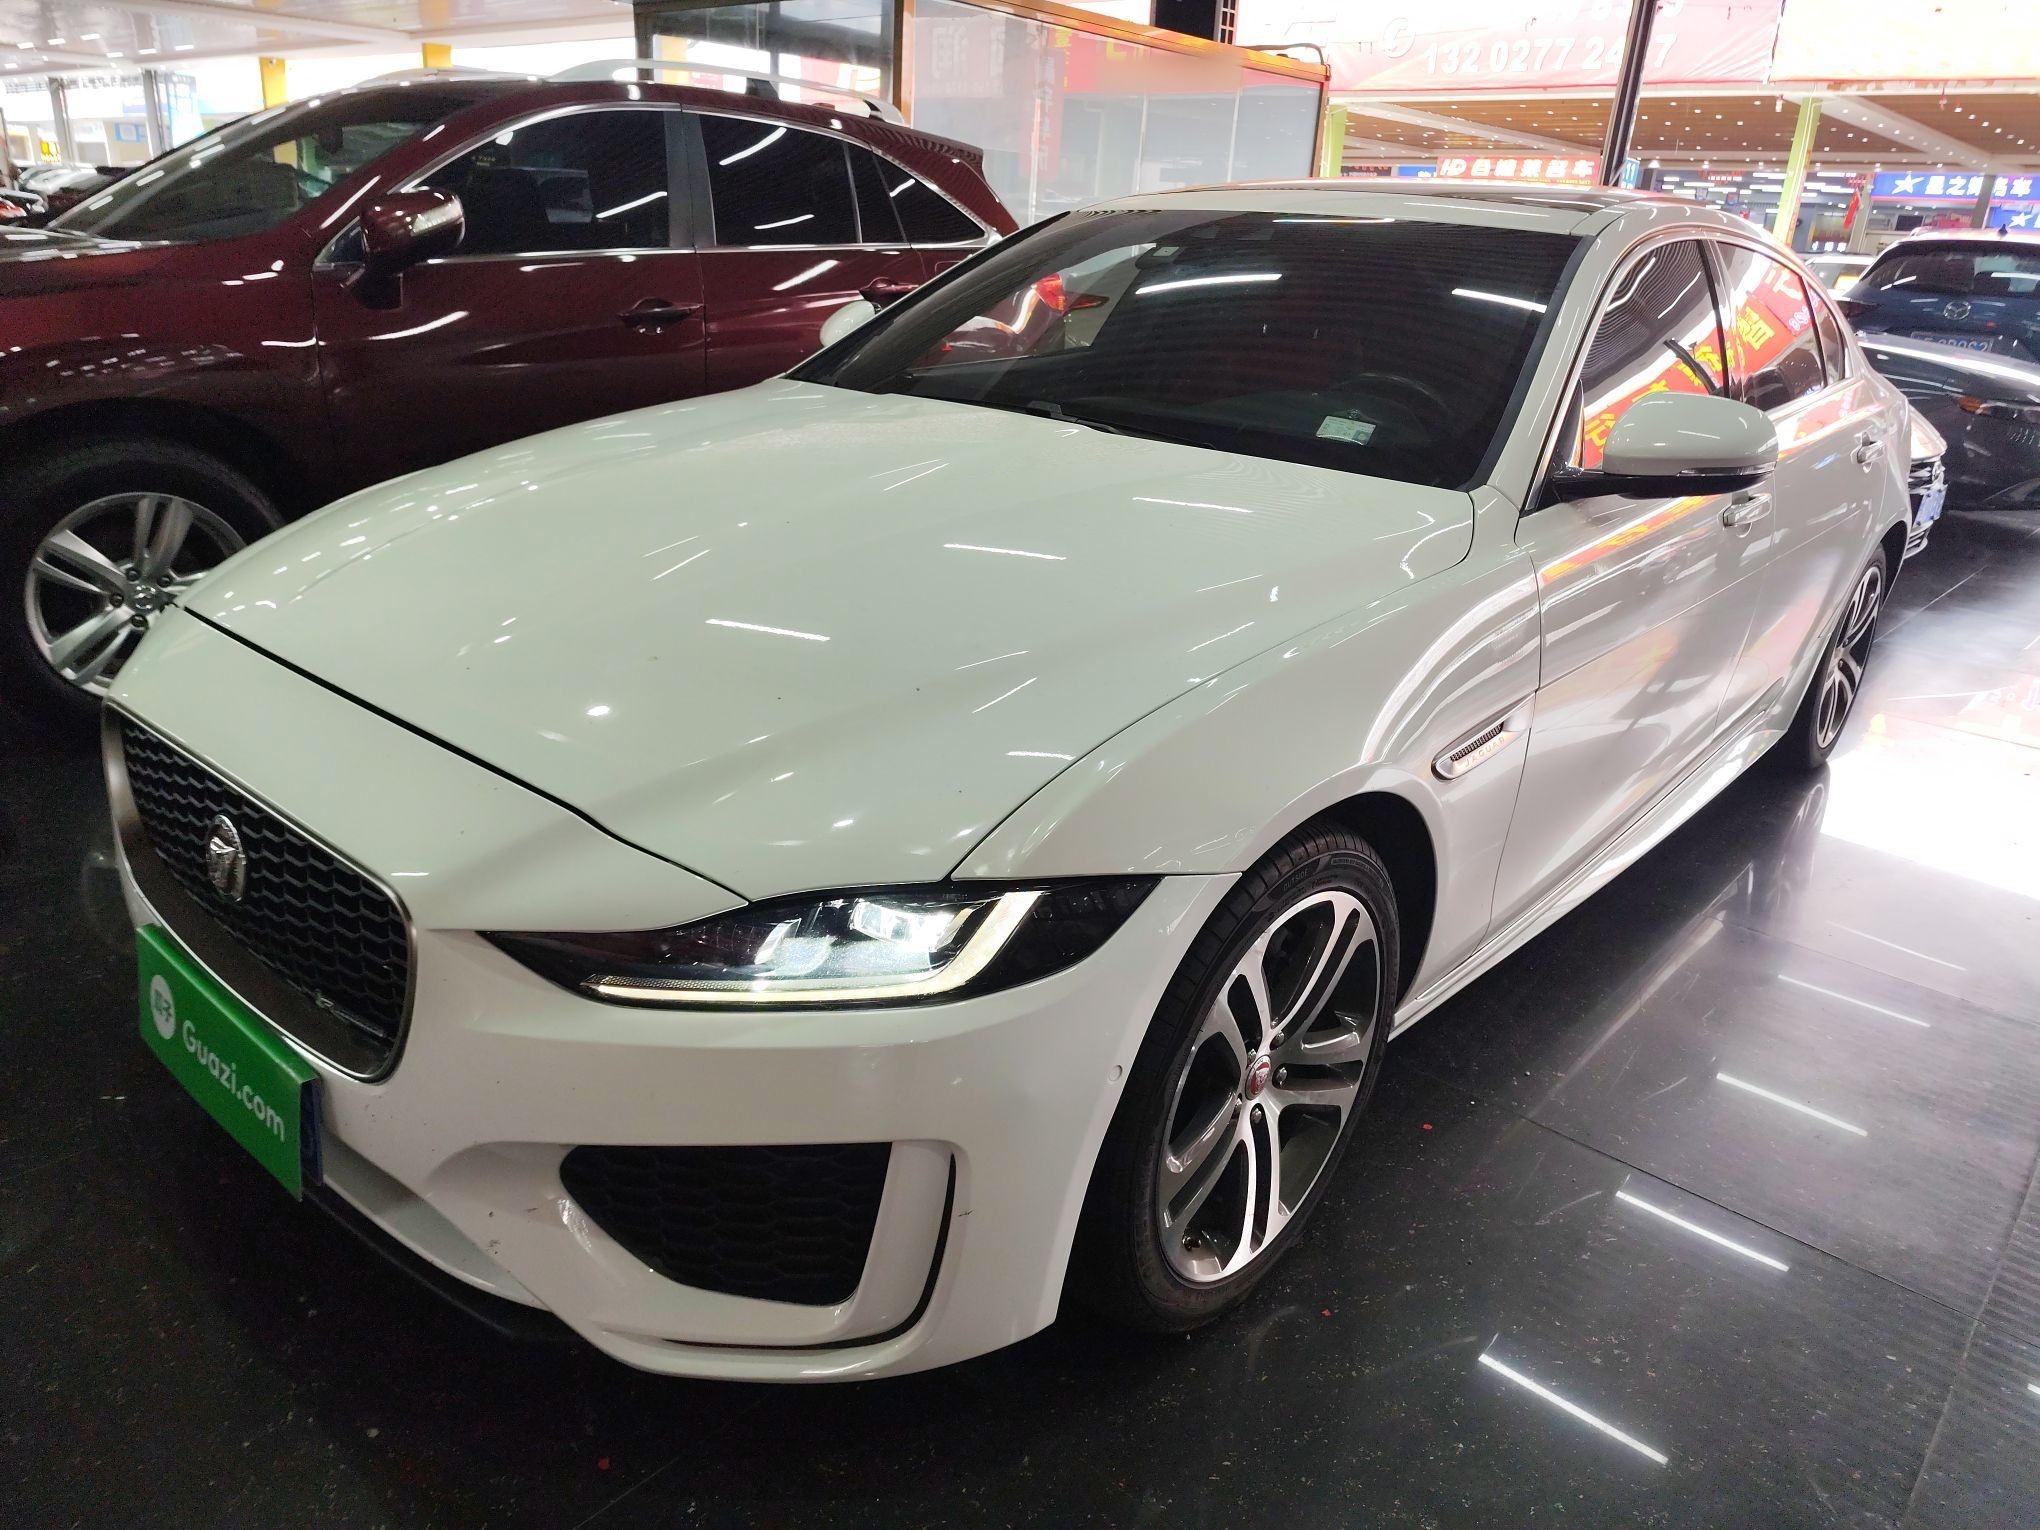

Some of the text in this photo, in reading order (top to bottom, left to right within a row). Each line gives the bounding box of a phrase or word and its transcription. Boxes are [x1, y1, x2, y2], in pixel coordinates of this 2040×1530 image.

[1426, 32, 1679, 75] 132 0277 247
[1465, 736, 1505, 768] JAGUAR
[181, 1018, 286, 1144] Guazi.com
